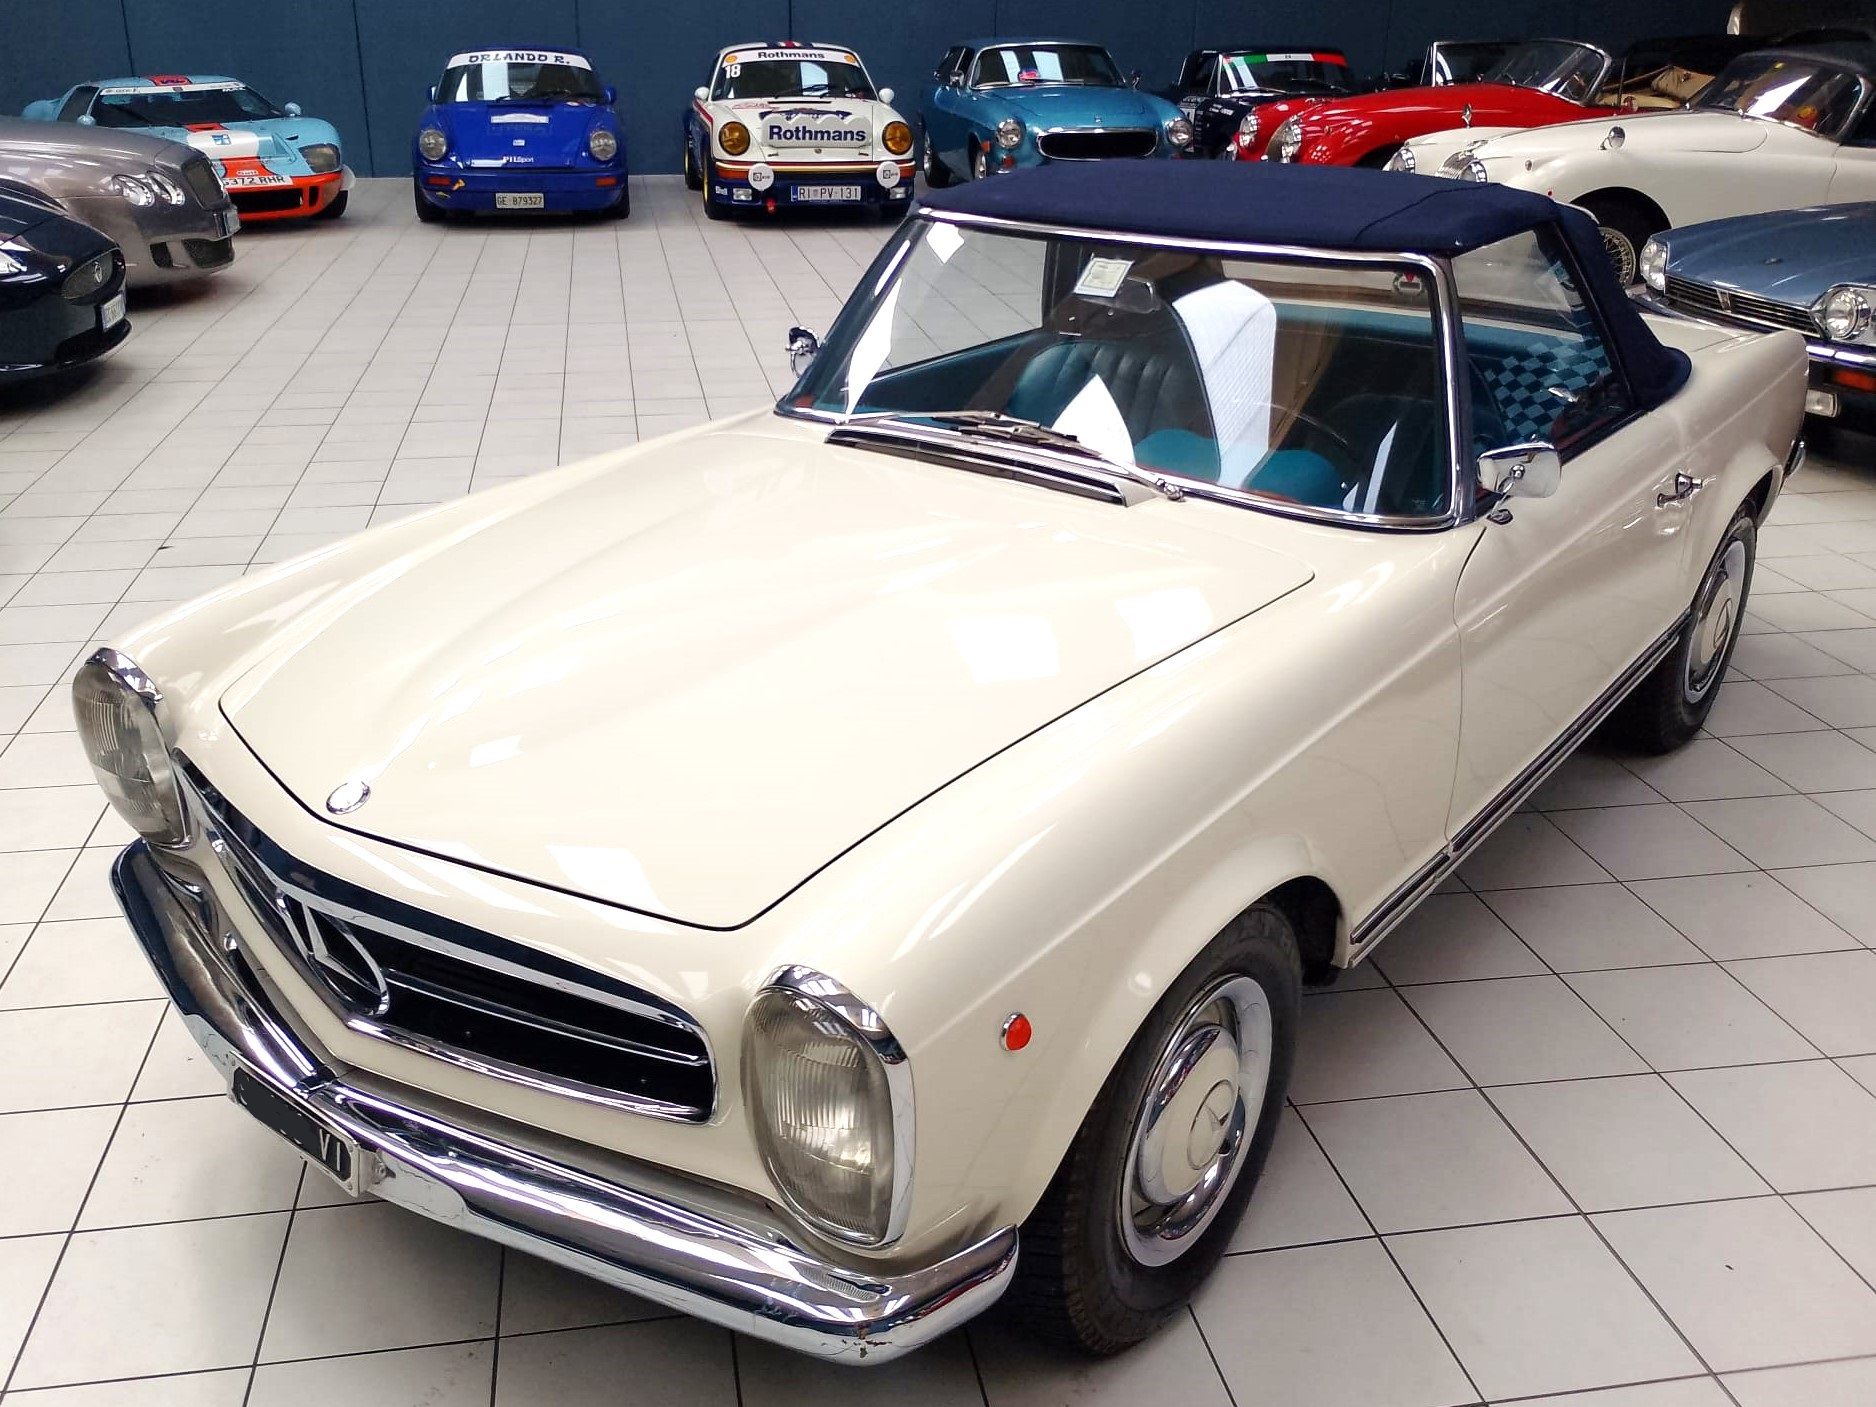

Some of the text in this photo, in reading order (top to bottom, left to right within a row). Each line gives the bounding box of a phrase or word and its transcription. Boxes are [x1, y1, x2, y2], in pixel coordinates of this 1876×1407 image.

[468, 52, 570, 64] ORLANDO R.
[757, 51, 825, 59] Rothmans
[725, 64, 741, 79] 18
[769, 125, 867, 141] Rothmans
[799, 187, 810, 199] RI
[497, 196, 543, 206] GE 879327
[319, 1129, 341, 1171] VI
